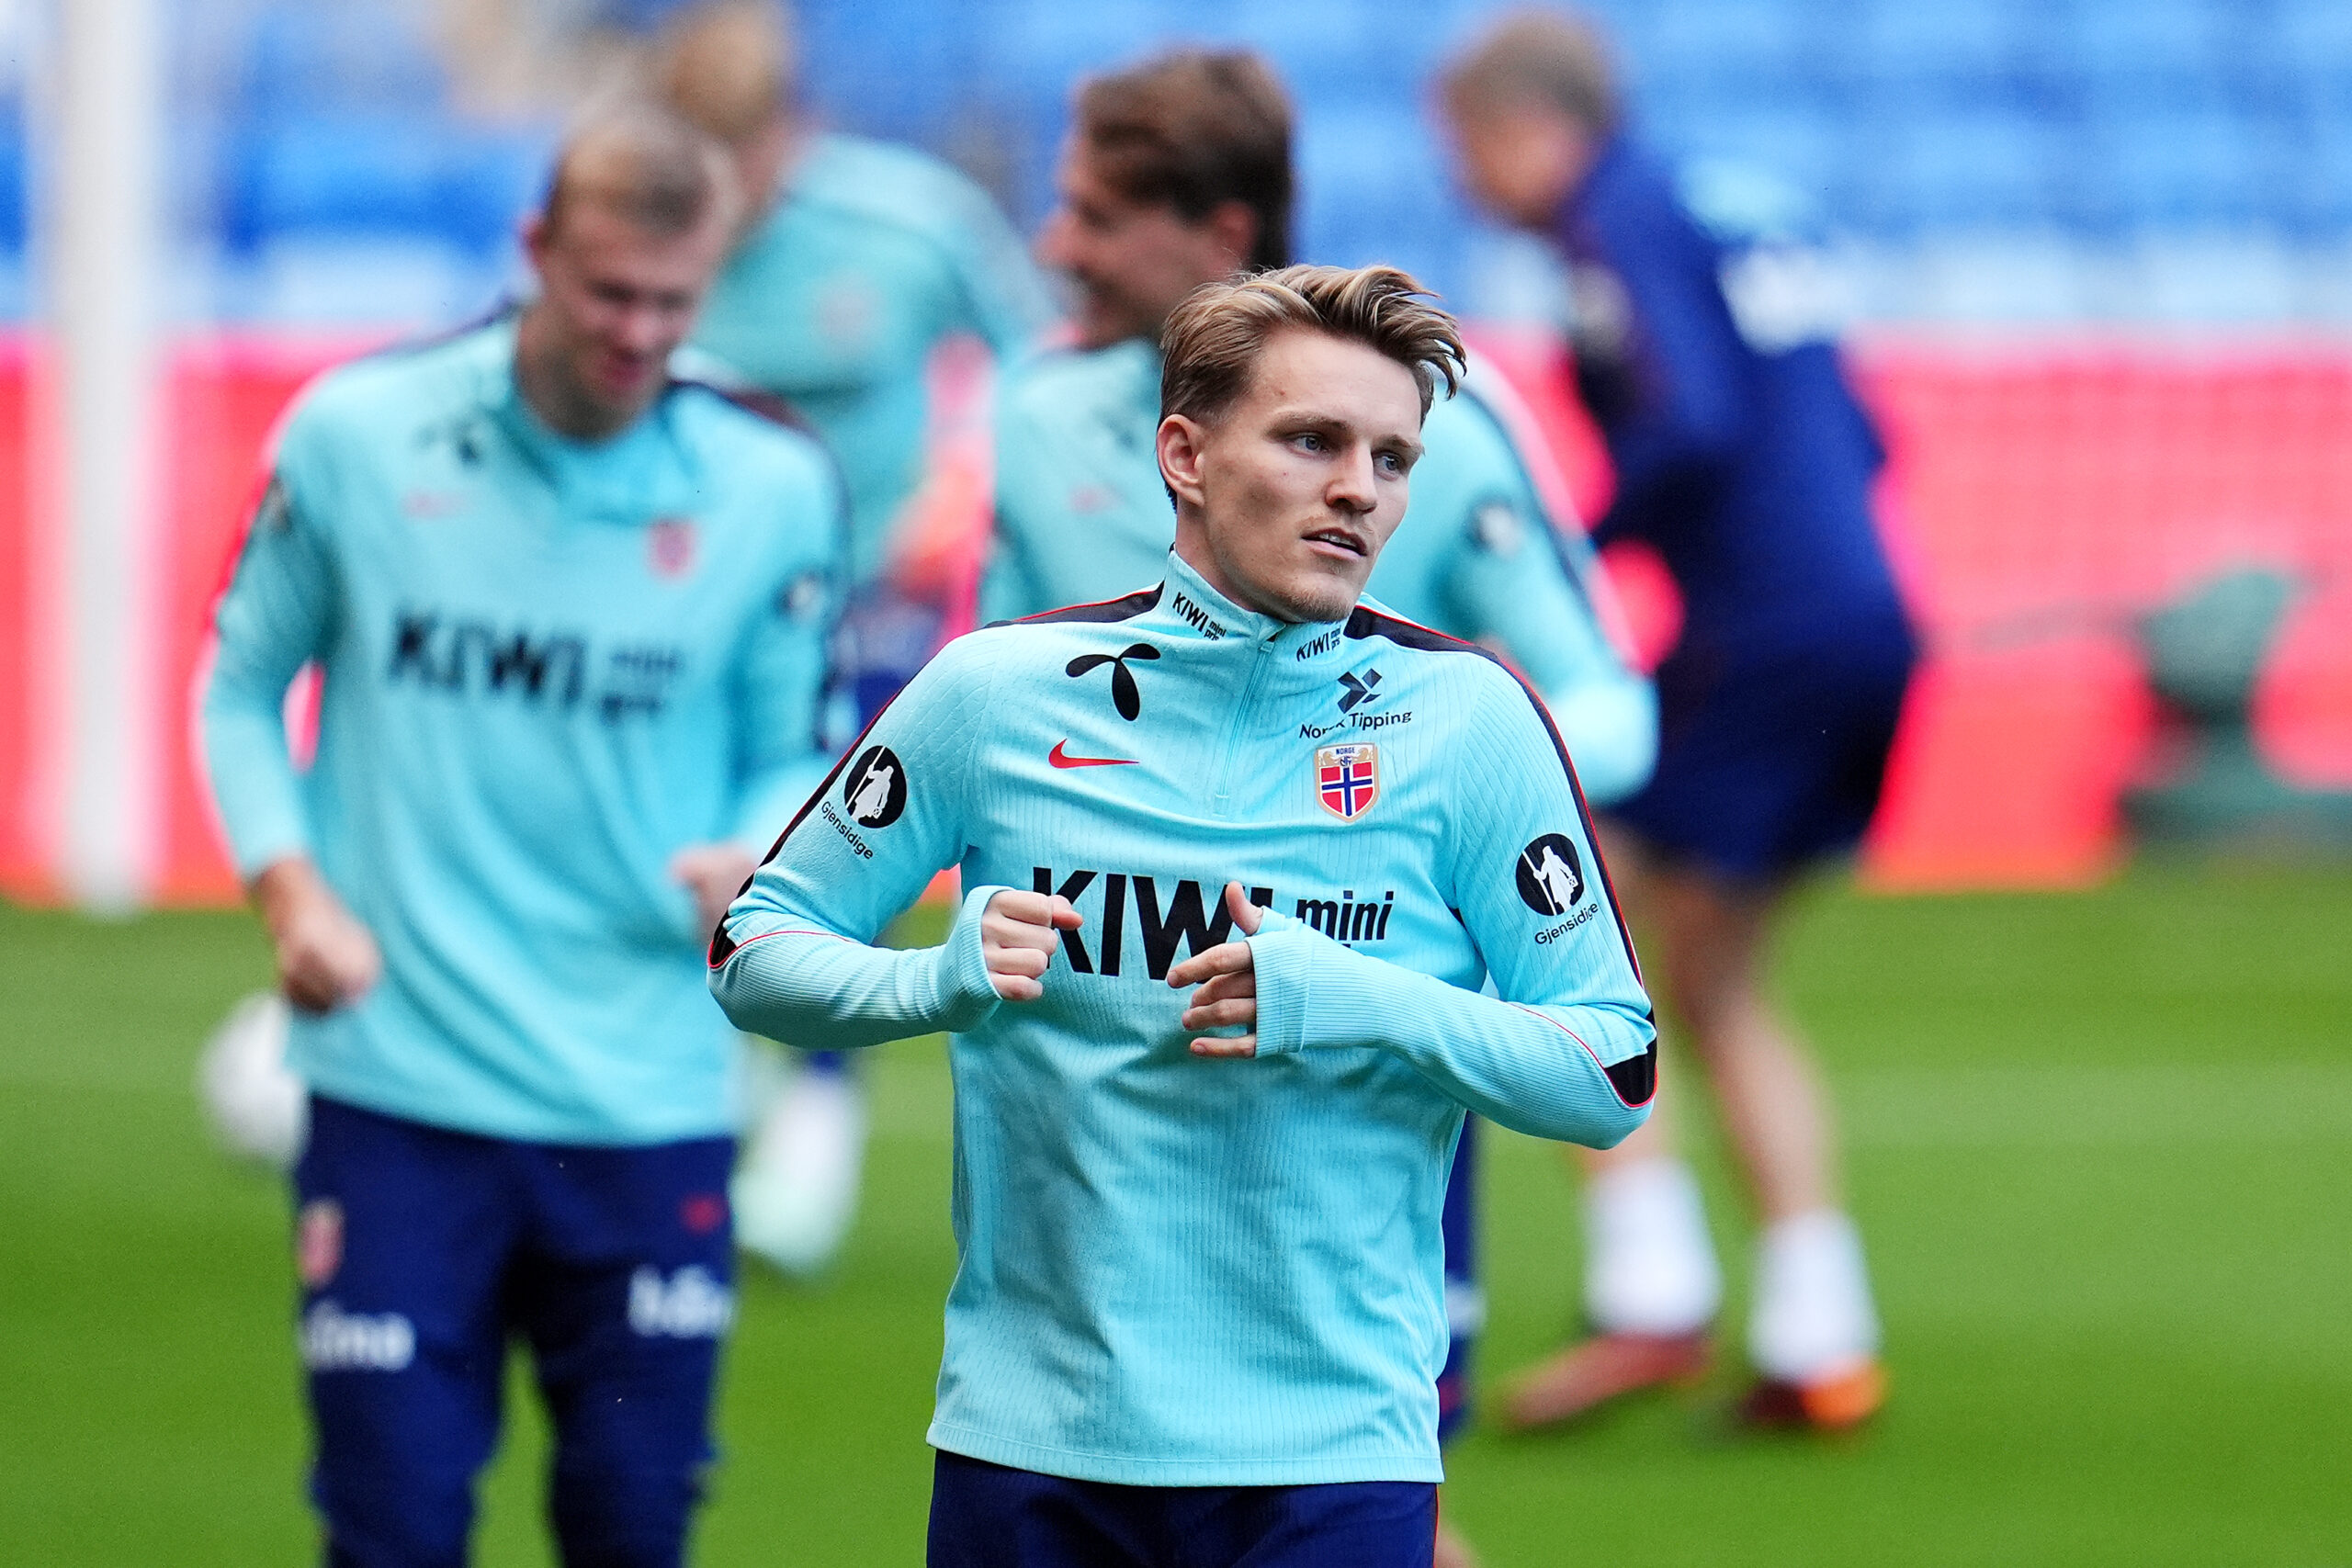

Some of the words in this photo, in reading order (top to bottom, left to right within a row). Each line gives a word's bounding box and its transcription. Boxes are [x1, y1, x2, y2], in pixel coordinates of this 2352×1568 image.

[1172, 592, 1209, 632] KIWI
[1296, 632, 1329, 661] KIWI
[1349, 711, 1412, 731] Tipping
[821, 801, 874, 860] Gjensidige
[1296, 890, 1395, 942] mini
